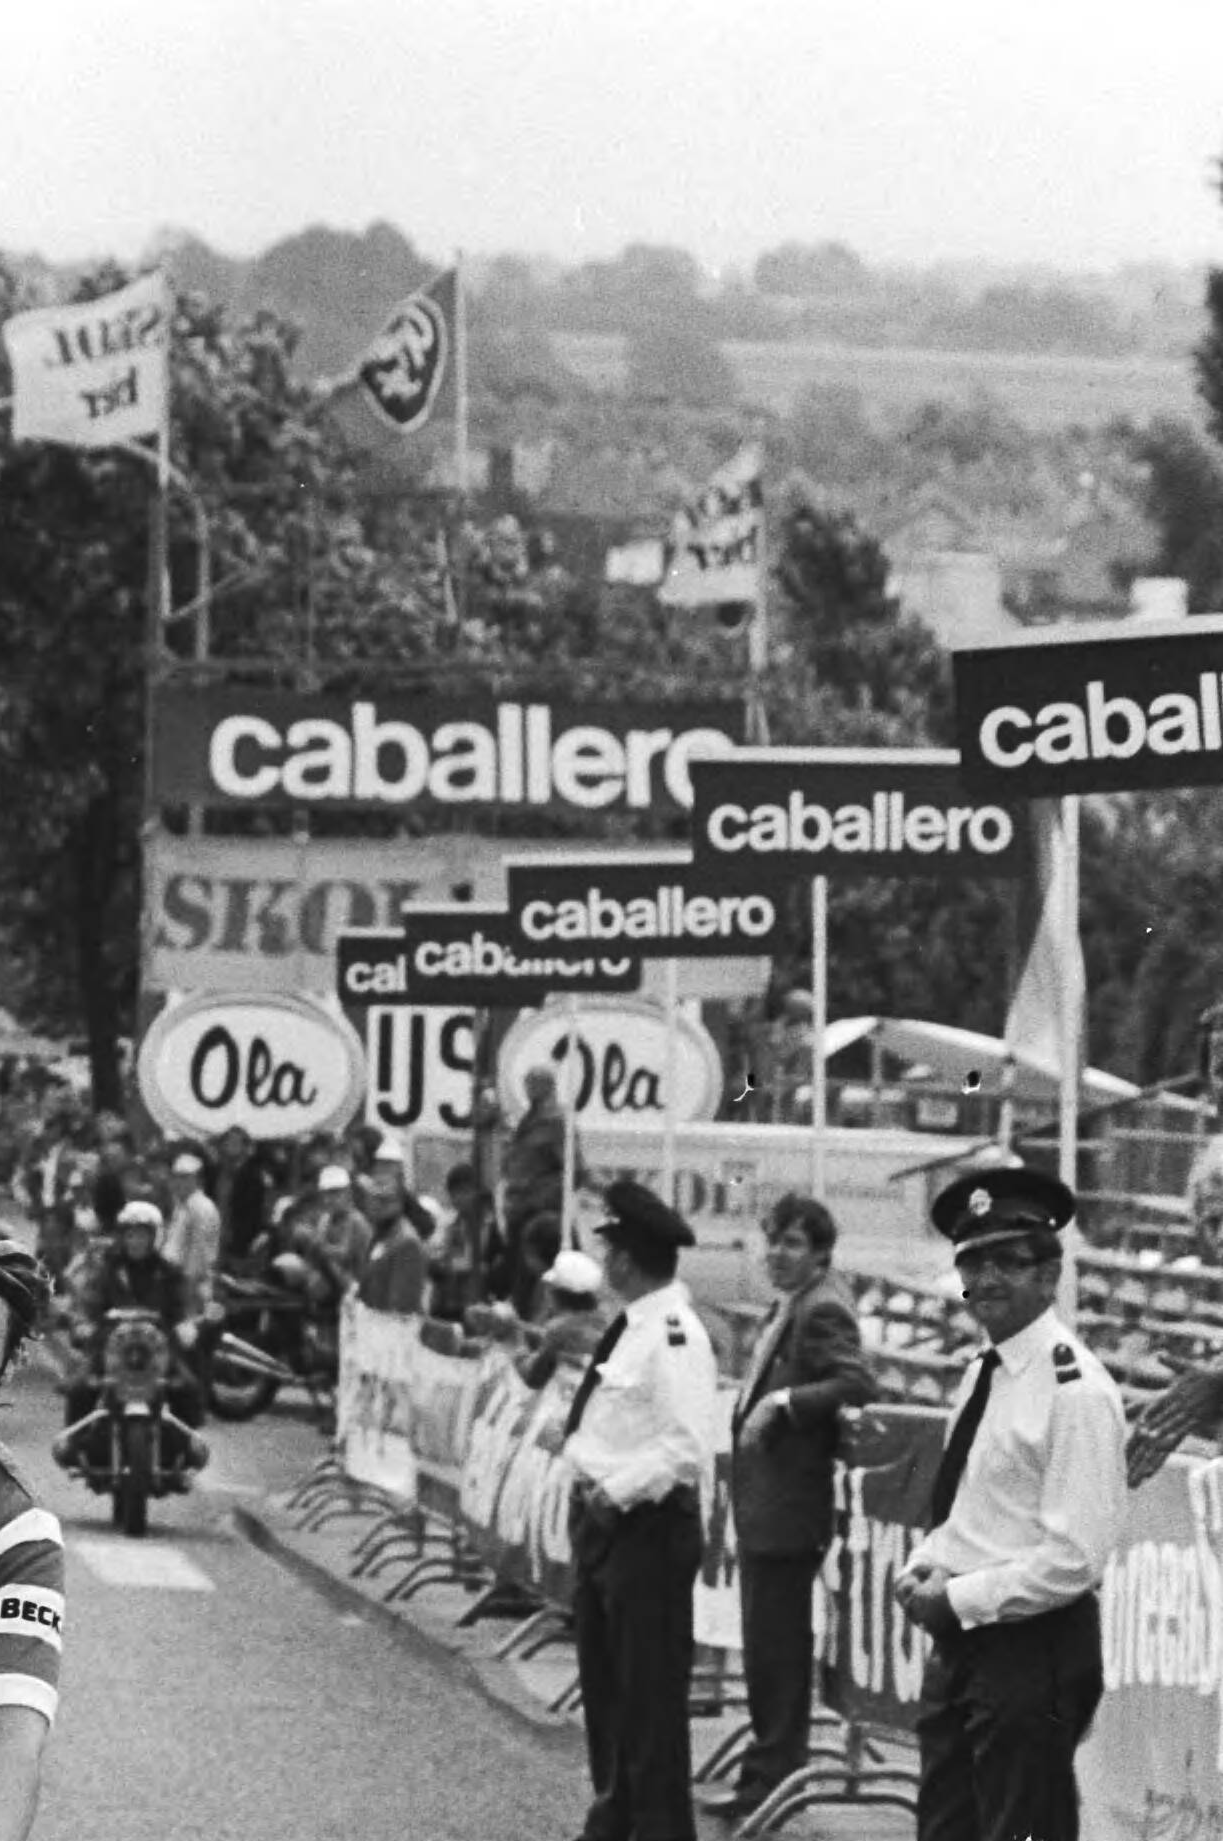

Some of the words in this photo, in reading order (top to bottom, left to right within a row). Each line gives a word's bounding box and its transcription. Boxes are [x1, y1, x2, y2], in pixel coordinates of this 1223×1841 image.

[979, 671, 1223, 769] cabal
[707, 790, 1013, 854] caballero
[520, 886, 776, 941] caballero
[189, 1024, 318, 1110] Ola
